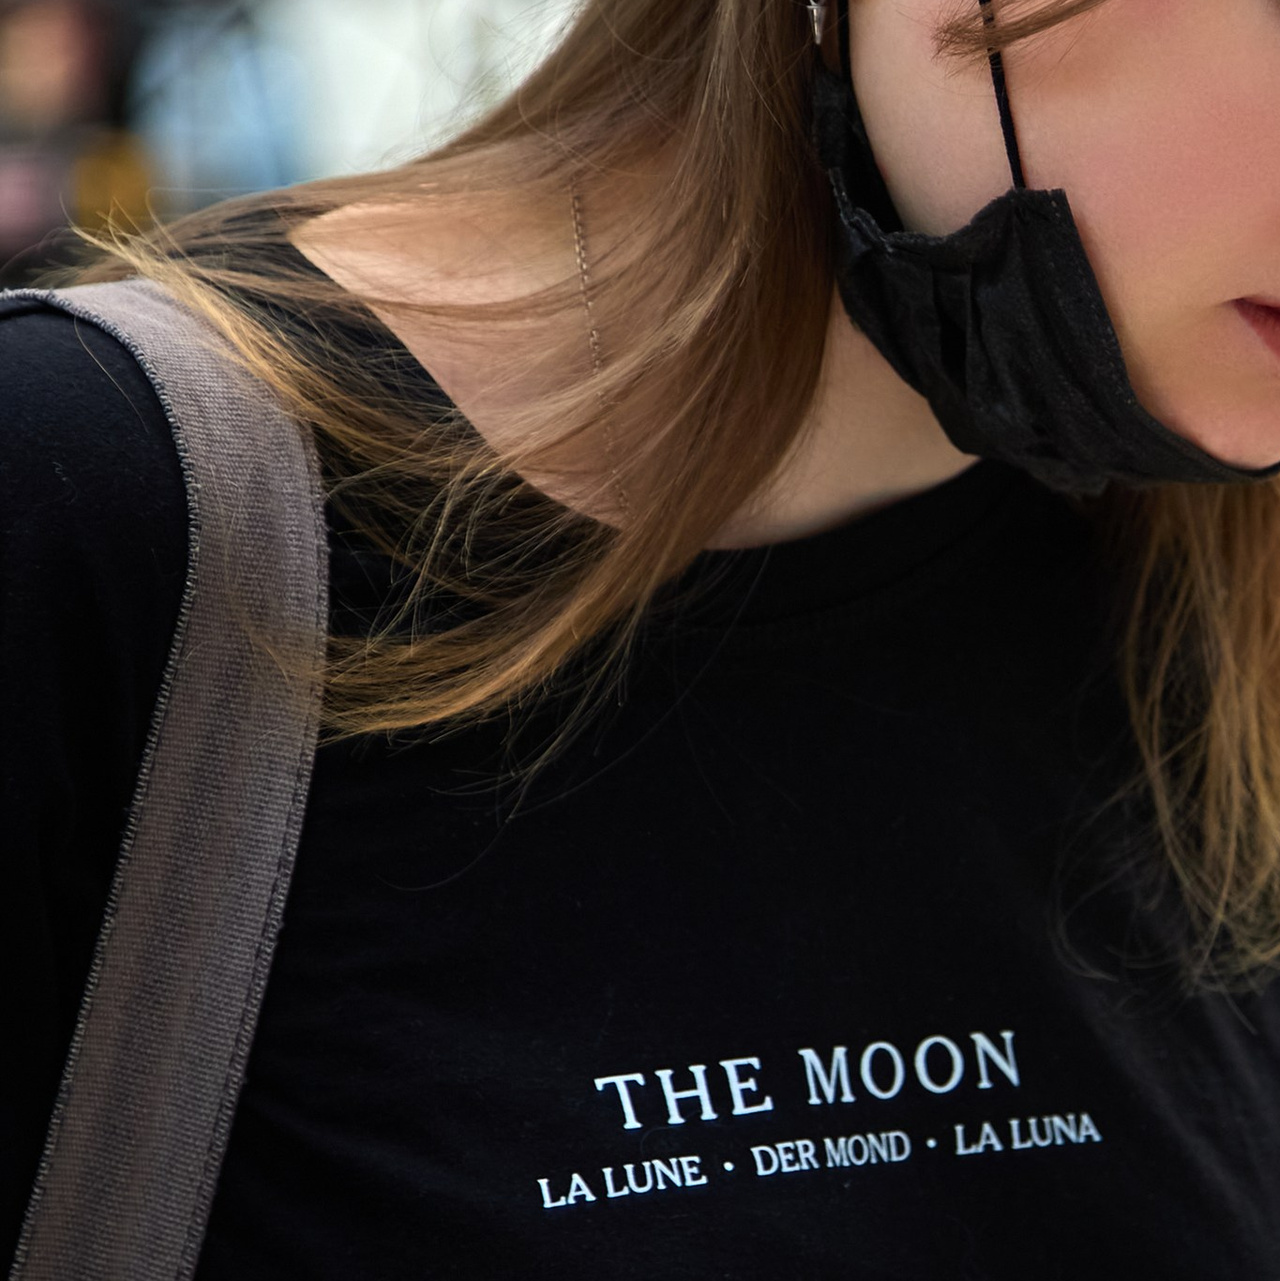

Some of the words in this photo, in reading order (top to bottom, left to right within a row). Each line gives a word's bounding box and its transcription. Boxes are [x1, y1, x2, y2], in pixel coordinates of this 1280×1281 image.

[594, 1057, 774, 1130] THE
[798, 1030, 1020, 1105] MOON
[537, 1172, 597, 1209] LA
[602, 1155, 708, 1199] LUNE
[751, 1139, 820, 1176] DER
[824, 1130, 911, 1168] MOND
[955, 1122, 1003, 1156] LA
[1010, 1113, 1102, 1150] LUNA
